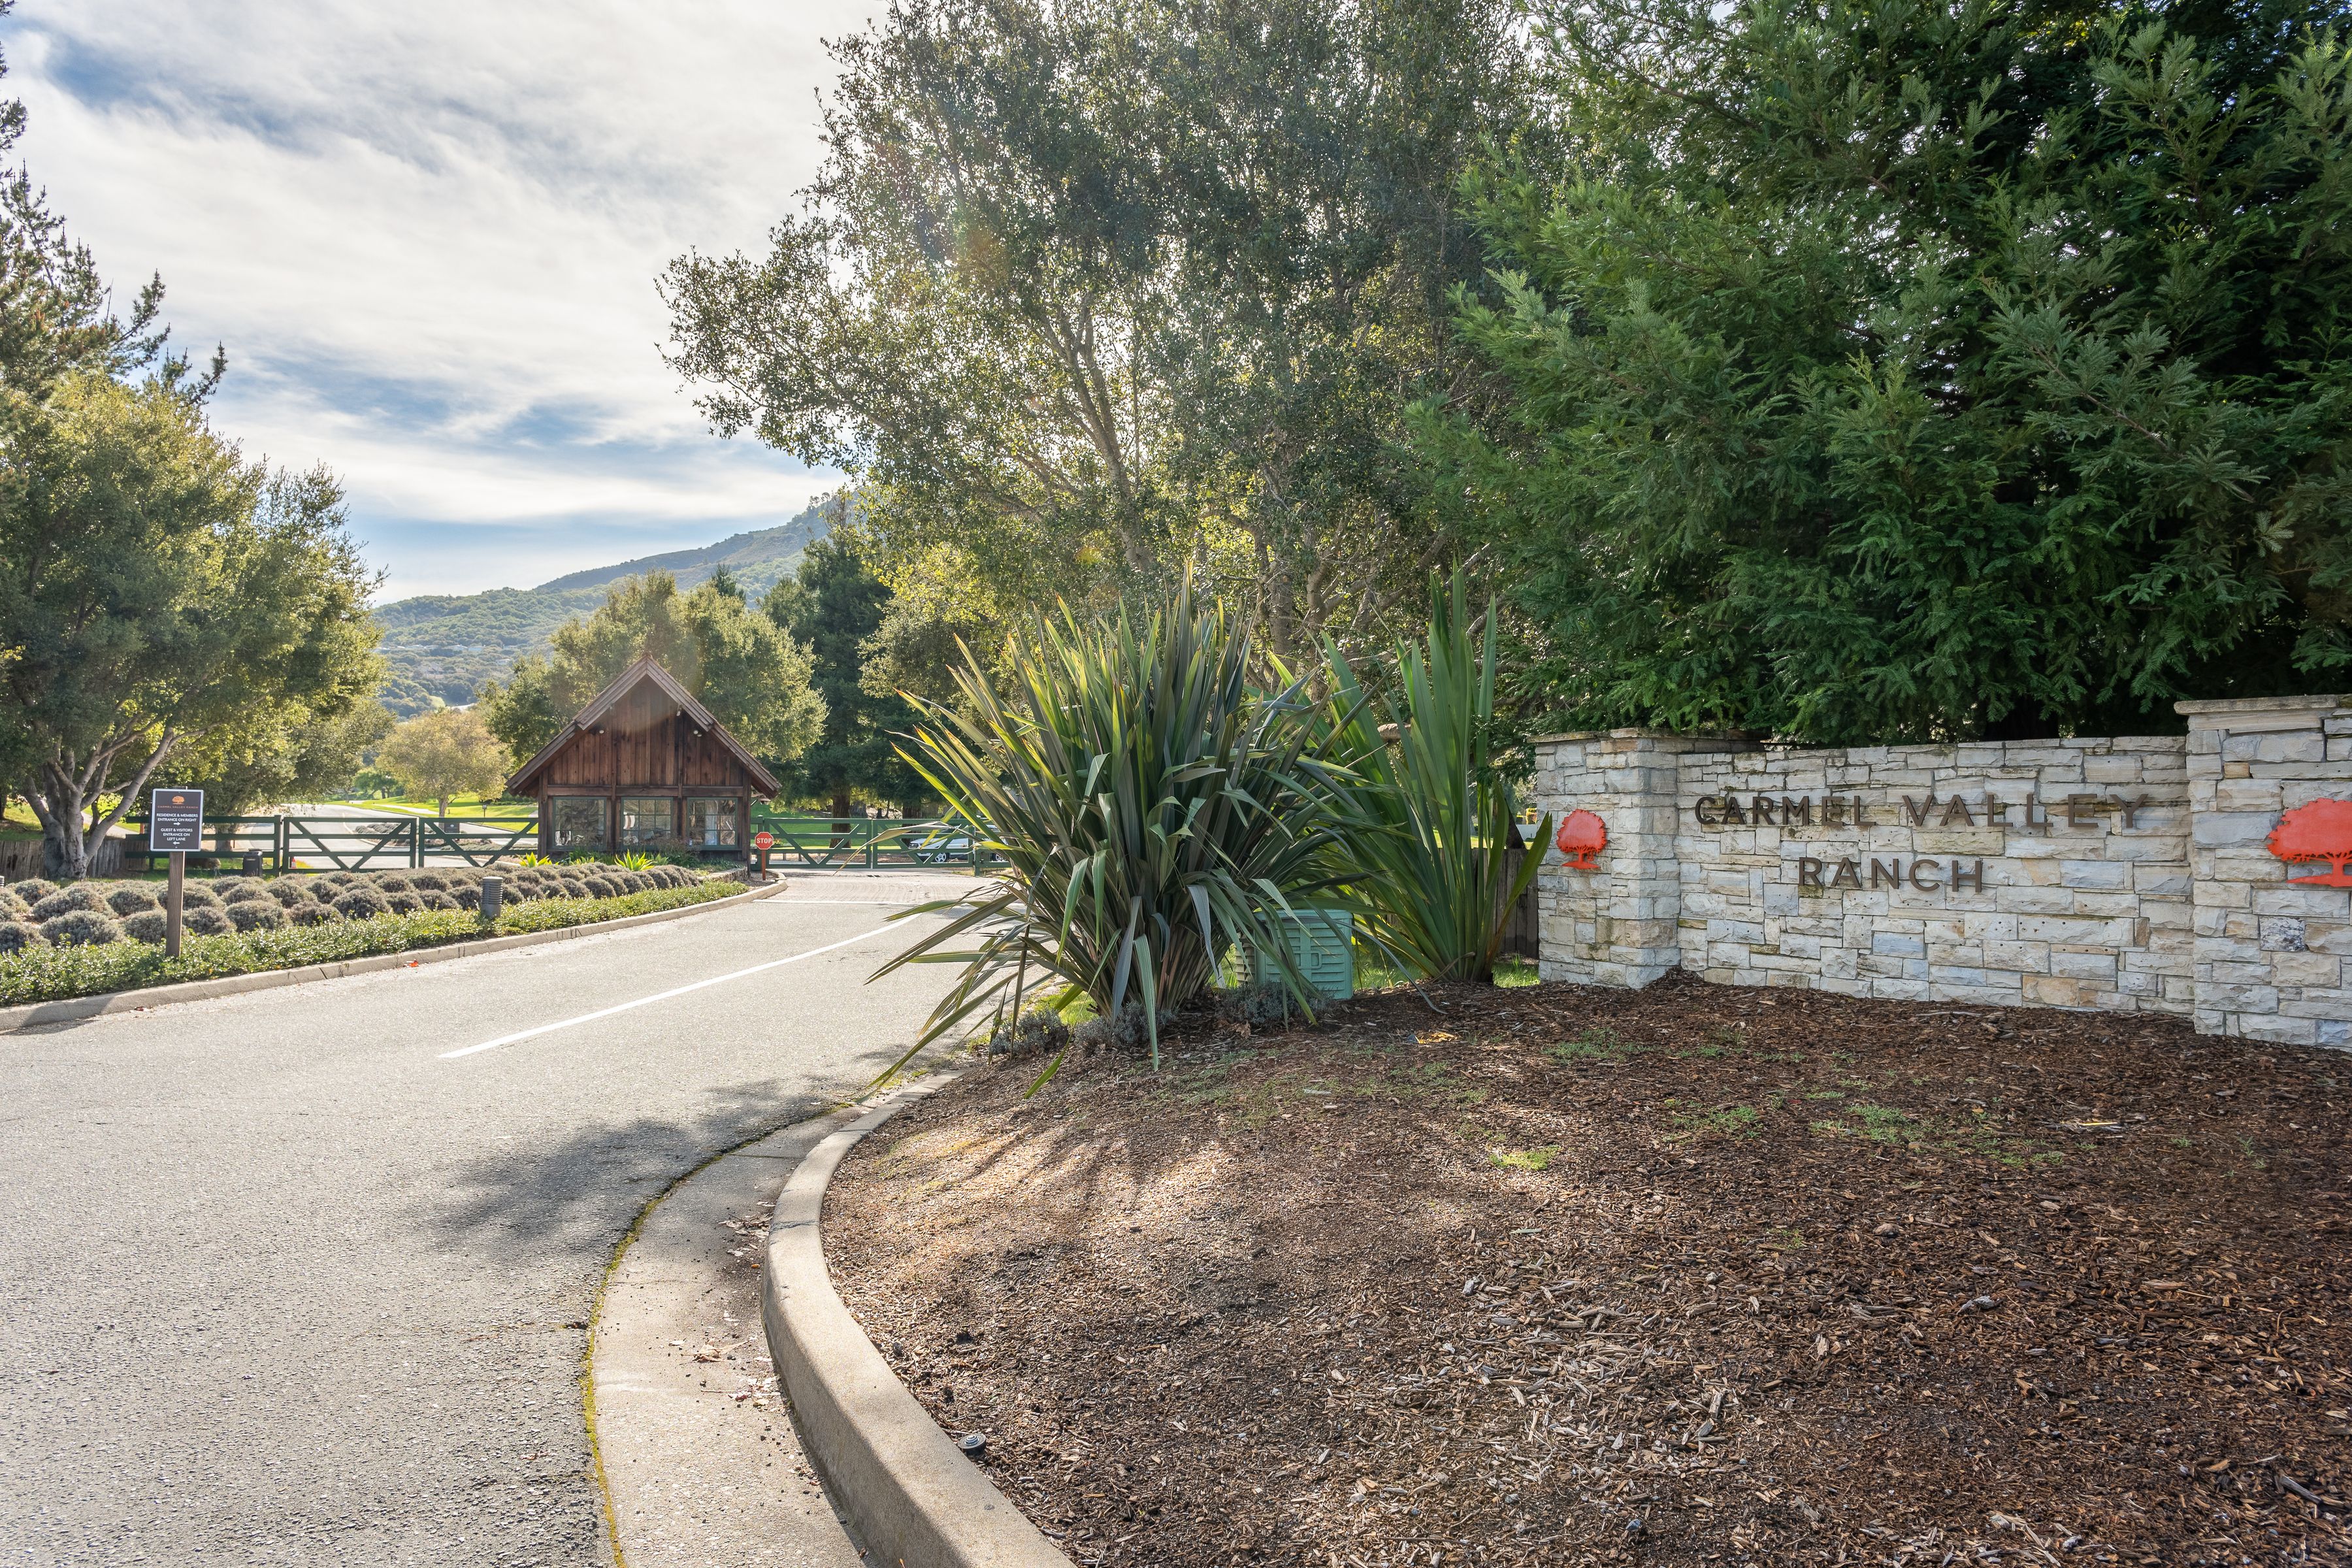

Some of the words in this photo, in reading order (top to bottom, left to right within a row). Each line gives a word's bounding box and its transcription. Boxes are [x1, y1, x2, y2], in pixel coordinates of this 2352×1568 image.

[1694, 795, 1876, 826] CARMEL
[1902, 793, 2149, 828] VALLEY
[1799, 857, 1983, 893] RANCH
